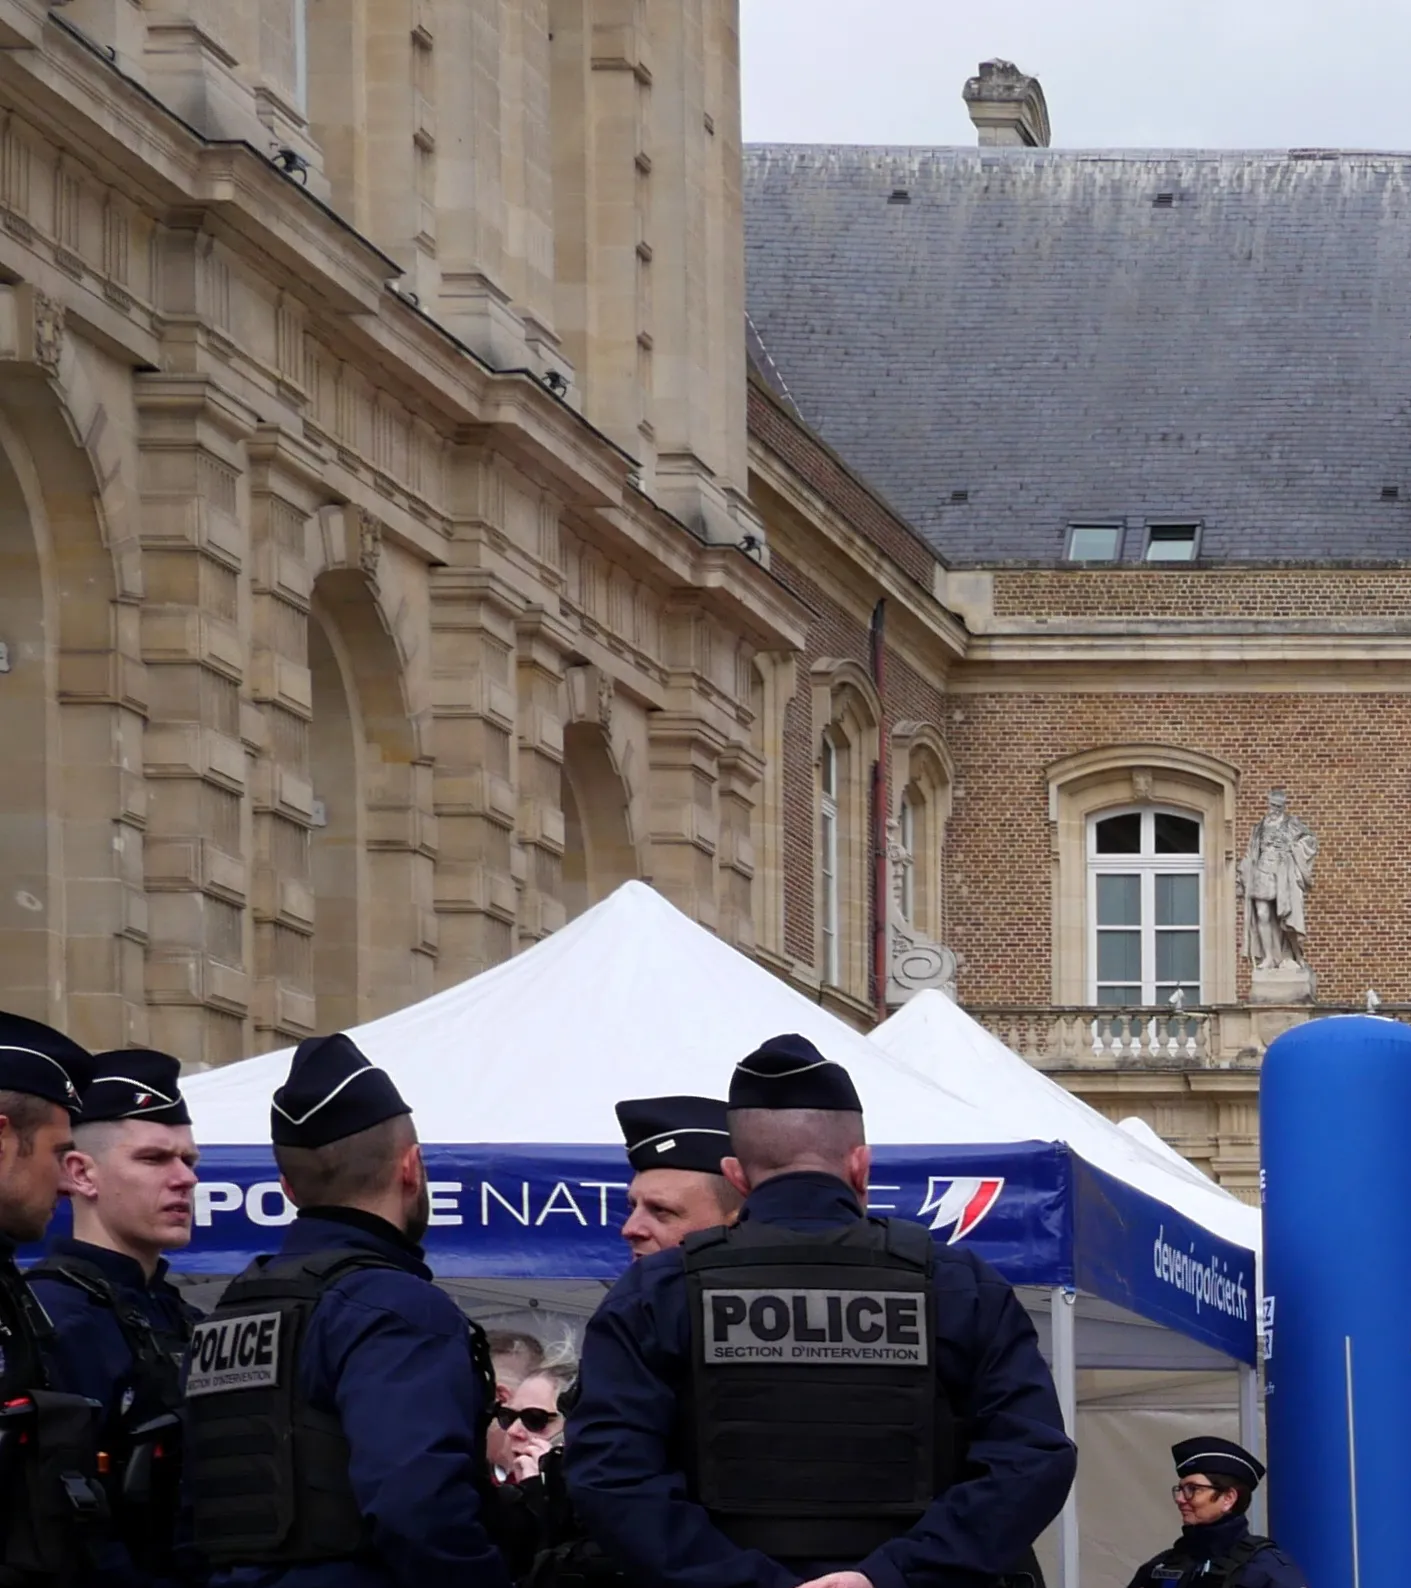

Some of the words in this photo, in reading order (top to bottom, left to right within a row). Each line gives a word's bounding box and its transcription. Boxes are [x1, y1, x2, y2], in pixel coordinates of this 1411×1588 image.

[194, 1182, 462, 1227] POE
[1154, 1224, 1247, 1321] devenirpolicier.fr
[711, 1295, 920, 1345] POLICE
[191, 1318, 277, 1373] POLICE
[714, 1346, 783, 1358] SECTION
[791, 1346, 919, 1360] D'INTERVENTION
